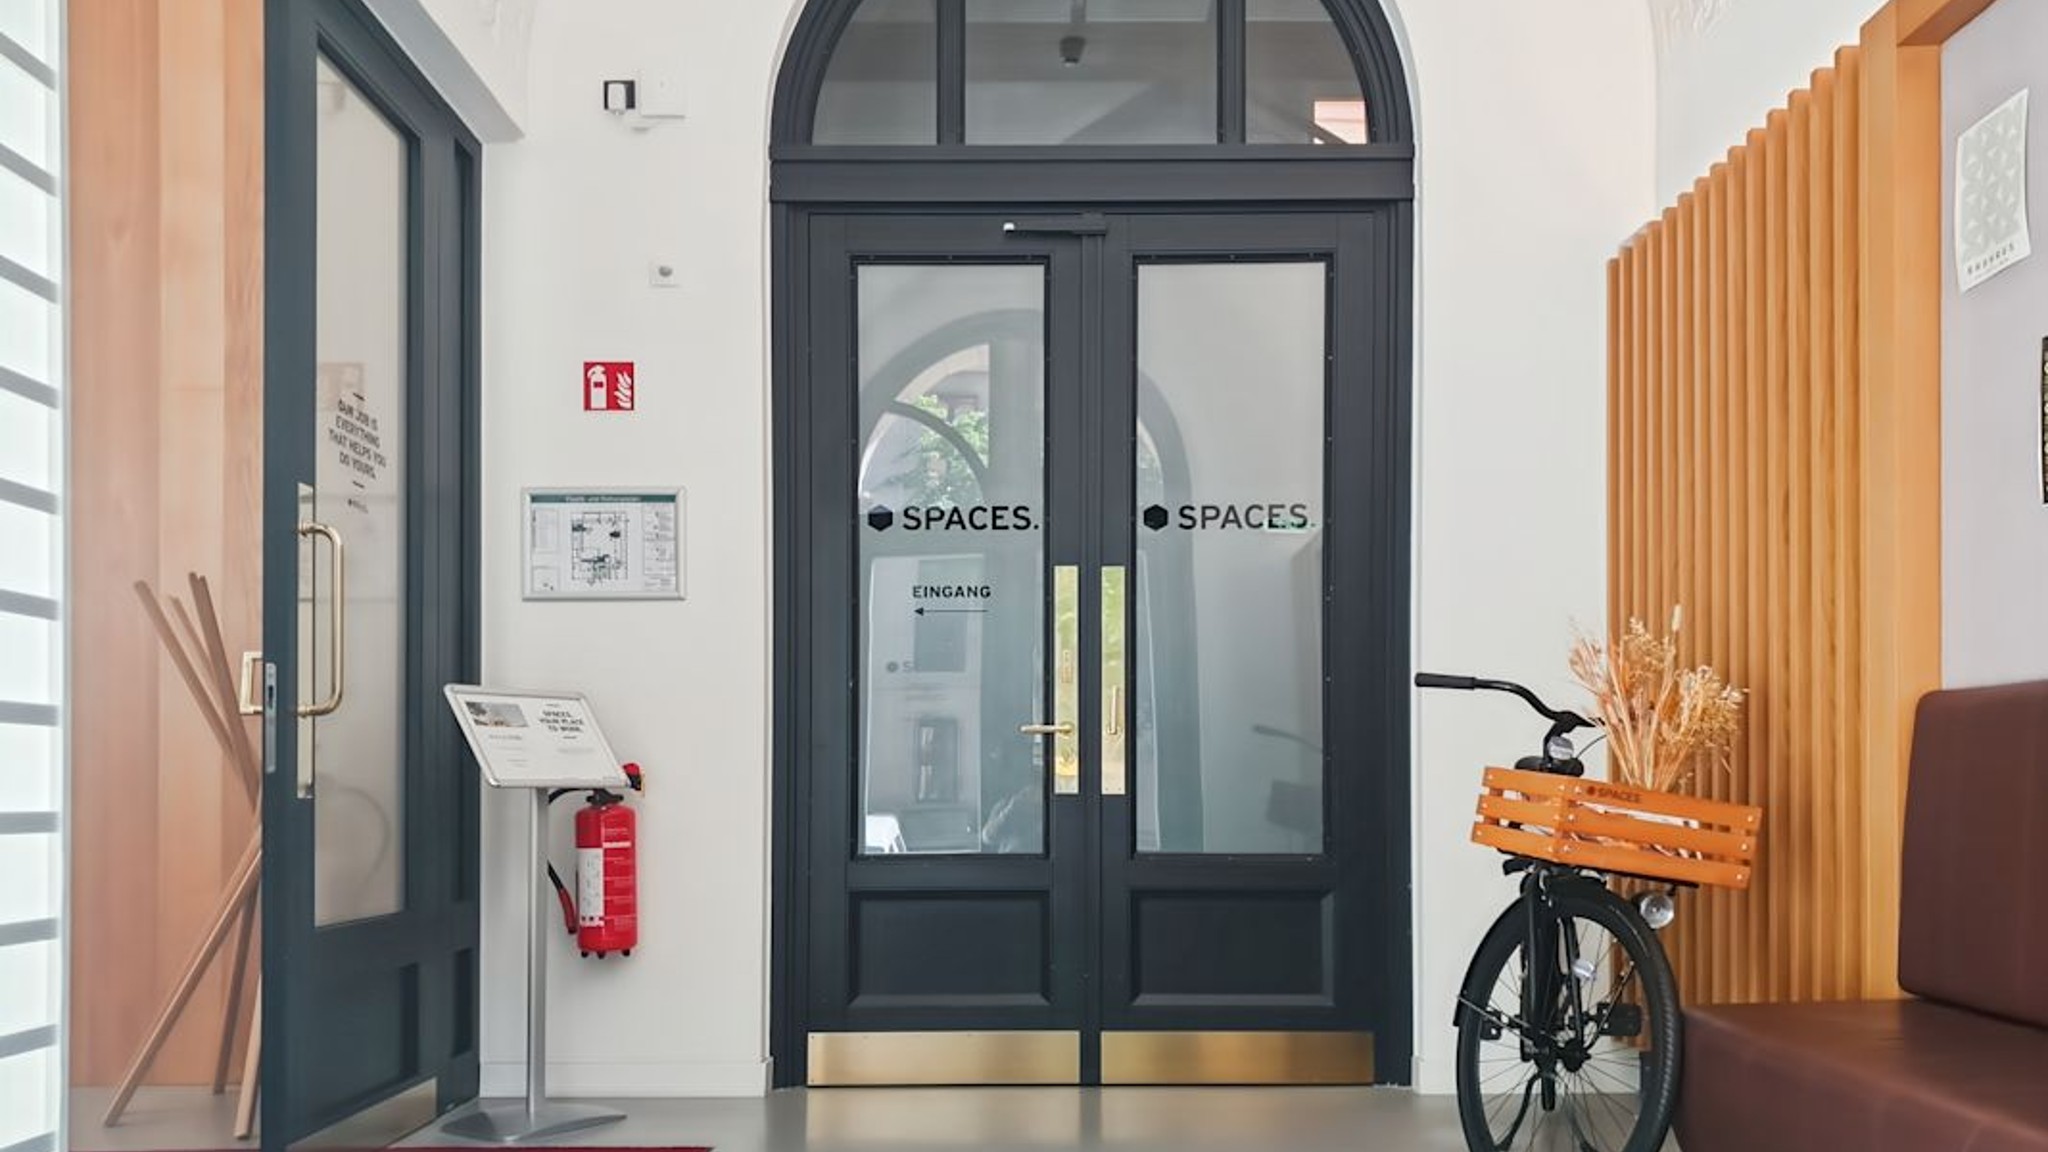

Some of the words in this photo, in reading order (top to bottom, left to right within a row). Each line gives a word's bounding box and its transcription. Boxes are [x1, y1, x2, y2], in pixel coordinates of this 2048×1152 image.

[337, 399, 353, 418] OUR
[355, 411, 369, 427] JOB
[335, 415, 380, 449] EVERYTHING
[329, 428, 347, 447] THAT
[348, 440, 371, 461] HELPS
[373, 452, 386, 468] YOU
[339, 451, 350, 466] DO
[902, 505, 1039, 531] SPACES.
[912, 585, 992, 599] EINGANG
